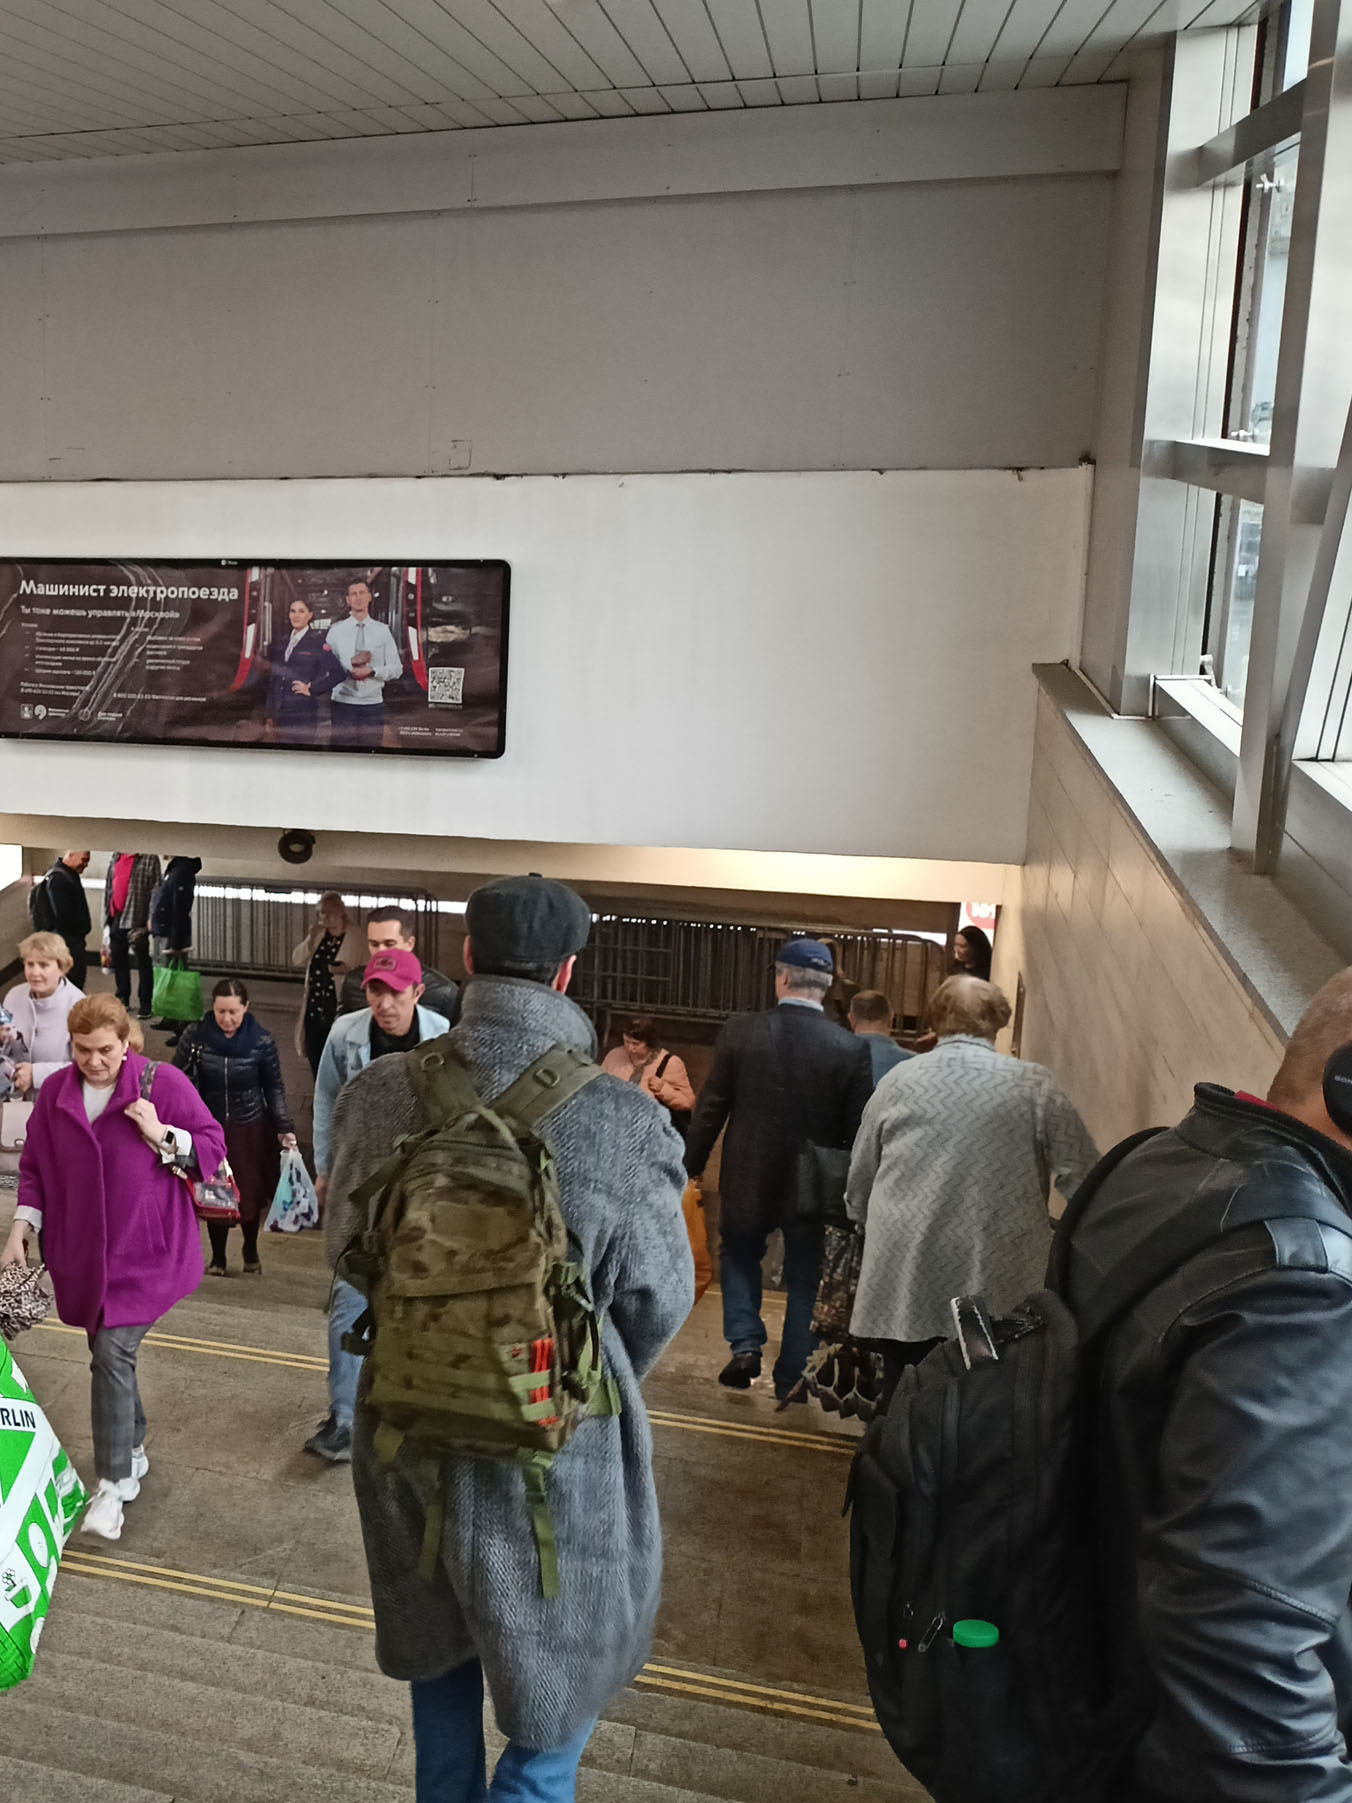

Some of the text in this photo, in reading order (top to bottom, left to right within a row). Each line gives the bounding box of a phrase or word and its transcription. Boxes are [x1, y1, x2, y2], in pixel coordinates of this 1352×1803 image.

[19, 579, 239, 602] Машинист электропоезда
[20, 605, 31, 614] Ты
[32, 607, 50, 615] тоже
[87, 610, 129, 618] управлять
